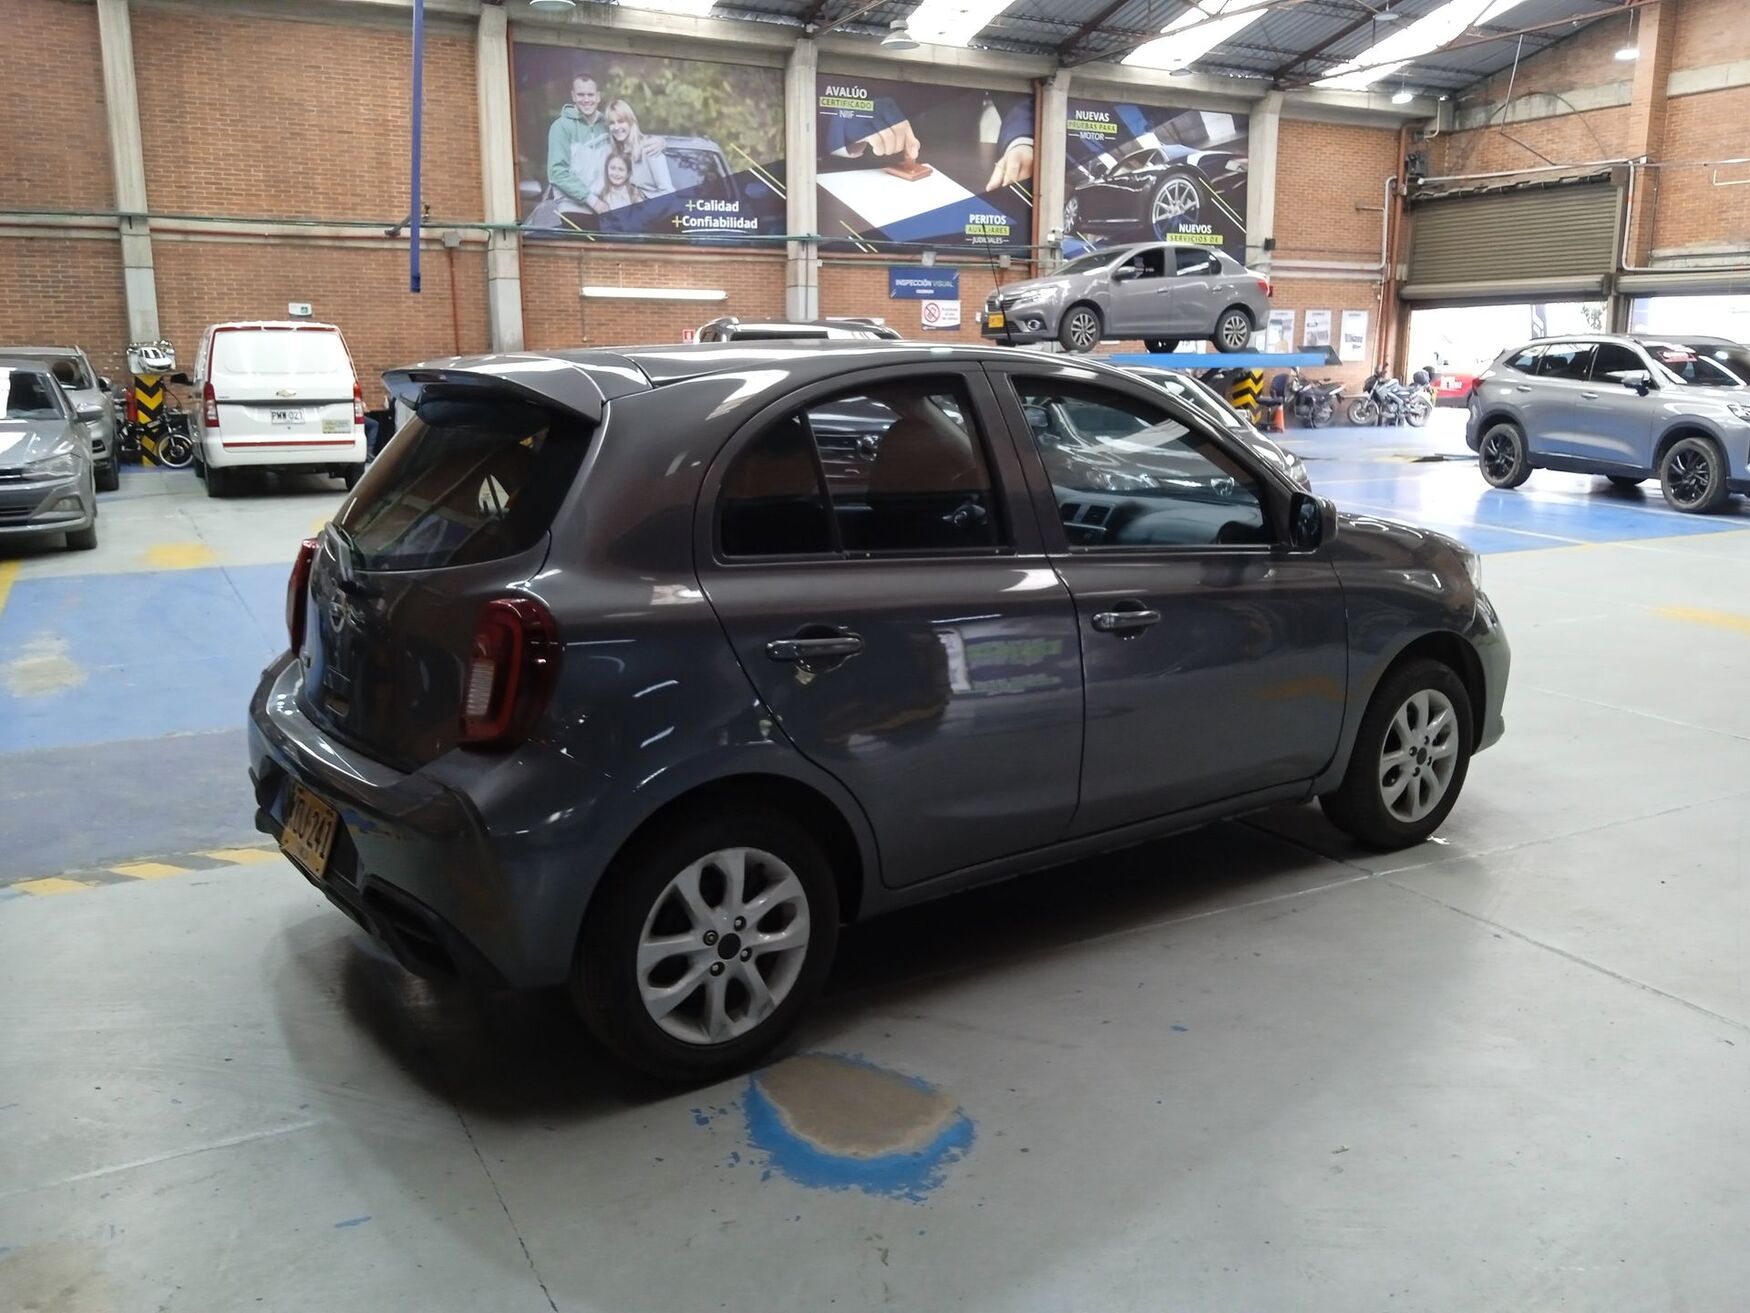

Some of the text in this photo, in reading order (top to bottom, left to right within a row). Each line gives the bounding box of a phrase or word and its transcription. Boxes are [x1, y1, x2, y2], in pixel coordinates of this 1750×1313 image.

[825, 85, 868, 99] AVALÚO
[821, 98, 872, 109] CERTIFICADO
[1075, 110, 1110, 122] NUEVAS
[1099, 123, 1116, 132] PARA
[1080, 131, 1105, 141] MOTOR
[969, 214, 1007, 225] PERITOS
[1179, 223, 1213, 234] NUEVOS
[1169, 234, 1208, 243] SERVICIOS
